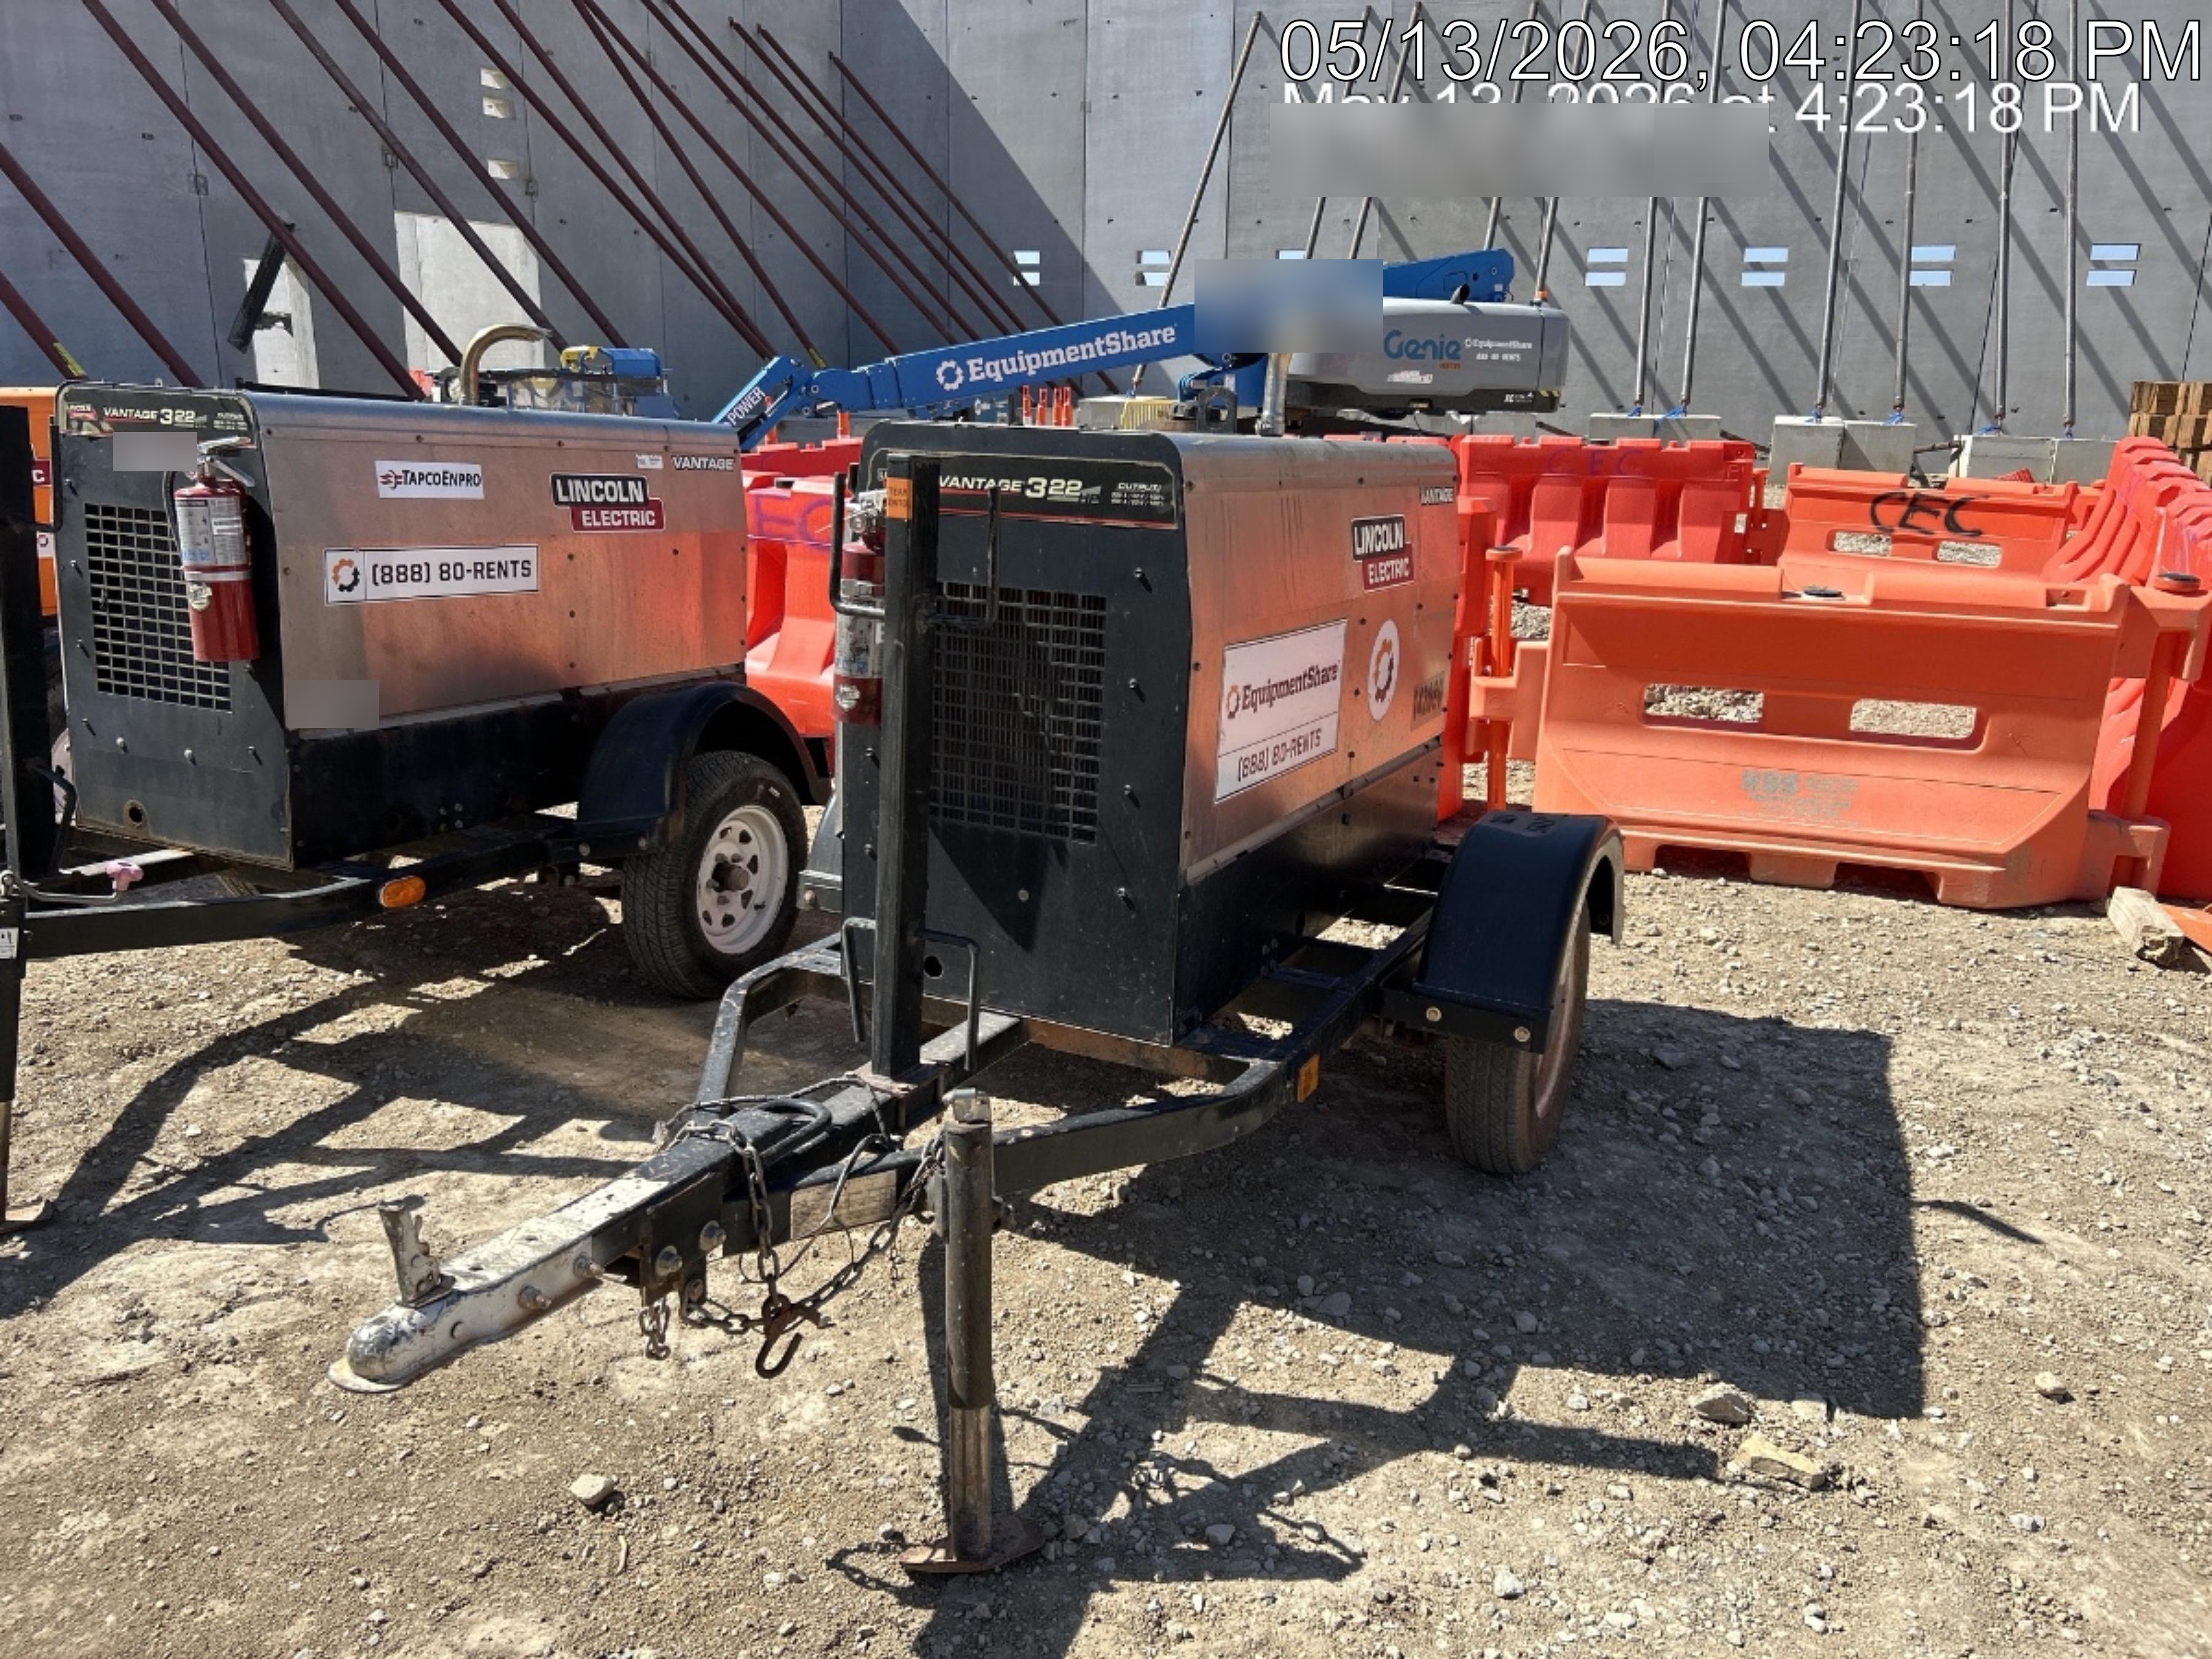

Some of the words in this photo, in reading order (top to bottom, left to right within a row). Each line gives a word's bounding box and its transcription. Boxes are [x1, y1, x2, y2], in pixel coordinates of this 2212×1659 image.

[967, 325, 1175, 383] EquipmentShare
[1383, 329, 1462, 360] Genie
[103, 407, 159, 420] VANTAGE
[160, 409, 195, 425] 322
[728, 386, 766, 426] POWER
[673, 456, 735, 471] VANTAGE
[555, 479, 644, 503] LINCOLN
[939, 476, 1023, 492] VANTAGE
[1025, 477, 1083, 498] 322
[581, 509, 656, 527] ELECTRIC
[1870, 492, 1991, 536] CEC
[1354, 522, 1404, 555] LINCOLN
[372, 562, 430, 587] (888)
[439, 560, 531, 581] 80-RENTS
[1368, 557, 1410, 585] ELECTRIC
[1242, 664, 1338, 713] EquipmentShare
[1238, 746, 1268, 782] (888)
[1272, 728, 1322, 766] 80-RENTS
